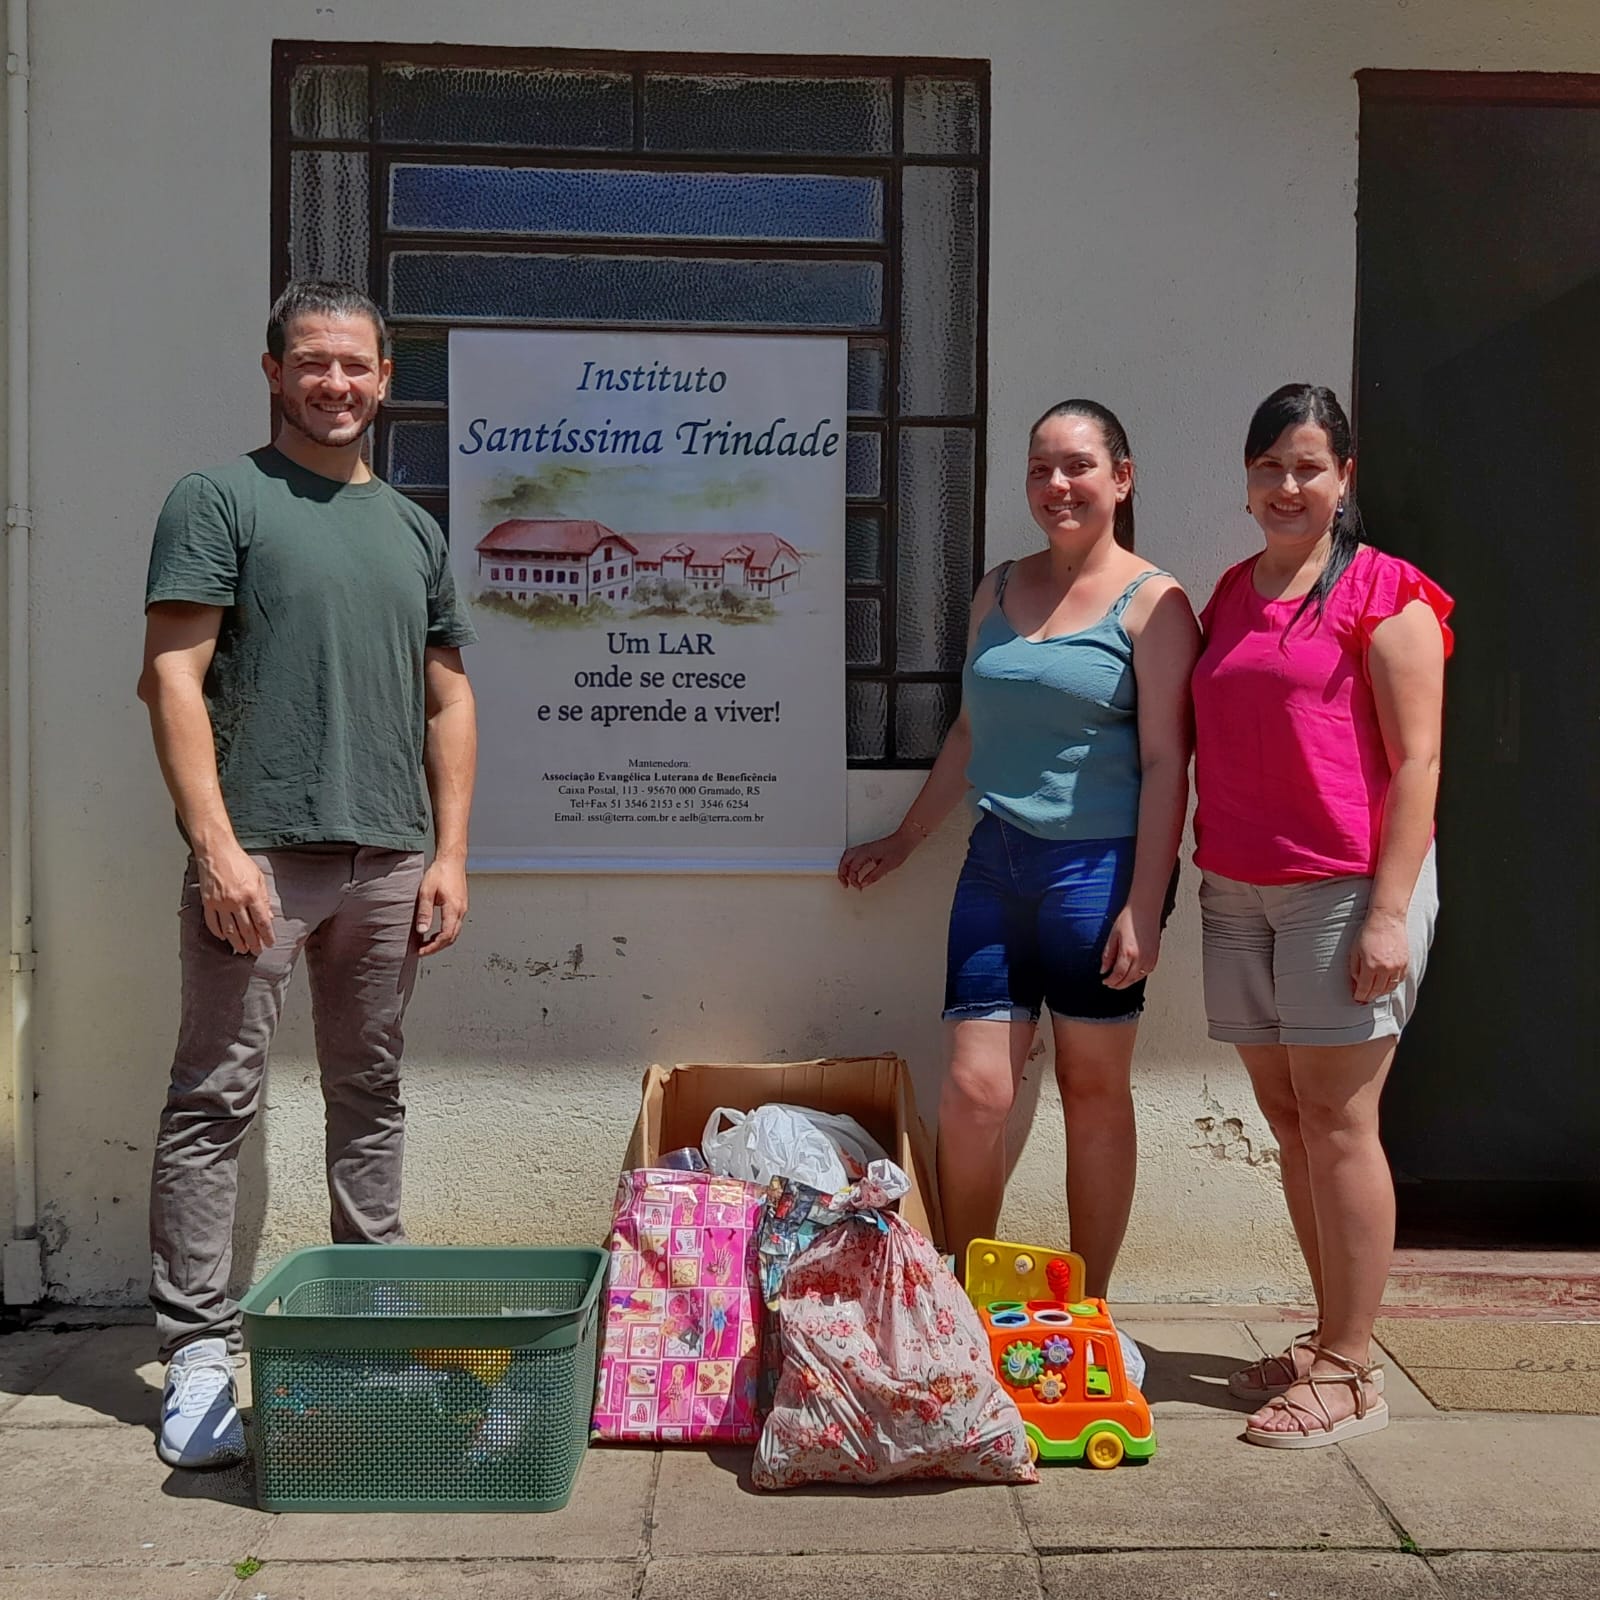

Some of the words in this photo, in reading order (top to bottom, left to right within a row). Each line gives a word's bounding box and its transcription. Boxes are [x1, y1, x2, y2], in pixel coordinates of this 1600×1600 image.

[575, 360, 727, 394] Instituto
[458, 417, 664, 455] Santíssima
[675, 417, 840, 458] Trindade
[607, 632, 650, 655] Um
[659, 632, 715, 656] LAR
[574, 664, 633, 688] onde
[640, 671, 665, 688] se
[672, 671, 747, 689] cresce
[537, 704, 551, 722] e
[558, 704, 584, 722] se
[590, 698, 687, 728] aprende
[694, 705, 708, 722] a
[714, 699, 781, 723] viver!
[541, 772, 595, 782] Associação
[598, 772, 651, 783] Evangélica
[654, 772, 699, 782] Luterana
[702, 772, 714, 782] de
[716, 772, 777, 782] Beneficência
[558, 785, 585, 795] Caixa
[588, 785, 619, 796] Postal,
[622, 785, 638, 795] 113
[647, 785, 676, 795] 95670
[678, 785, 696, 795] 000
[698, 785, 744, 796] Gramado,
[746, 786, 761, 795] RS
[570, 798, 608, 809] Tel+Fax
[610, 799, 621, 809] 51
[624, 799, 648, 809] 3546
[650, 799, 673, 809] 2153
[684, 799, 694, 809] 51
[700, 799, 724, 809] 3546
[726, 799, 749, 809] 6254
[671, 815, 677, 823] e
[679, 812, 765, 824] aelb@terra.com.br
